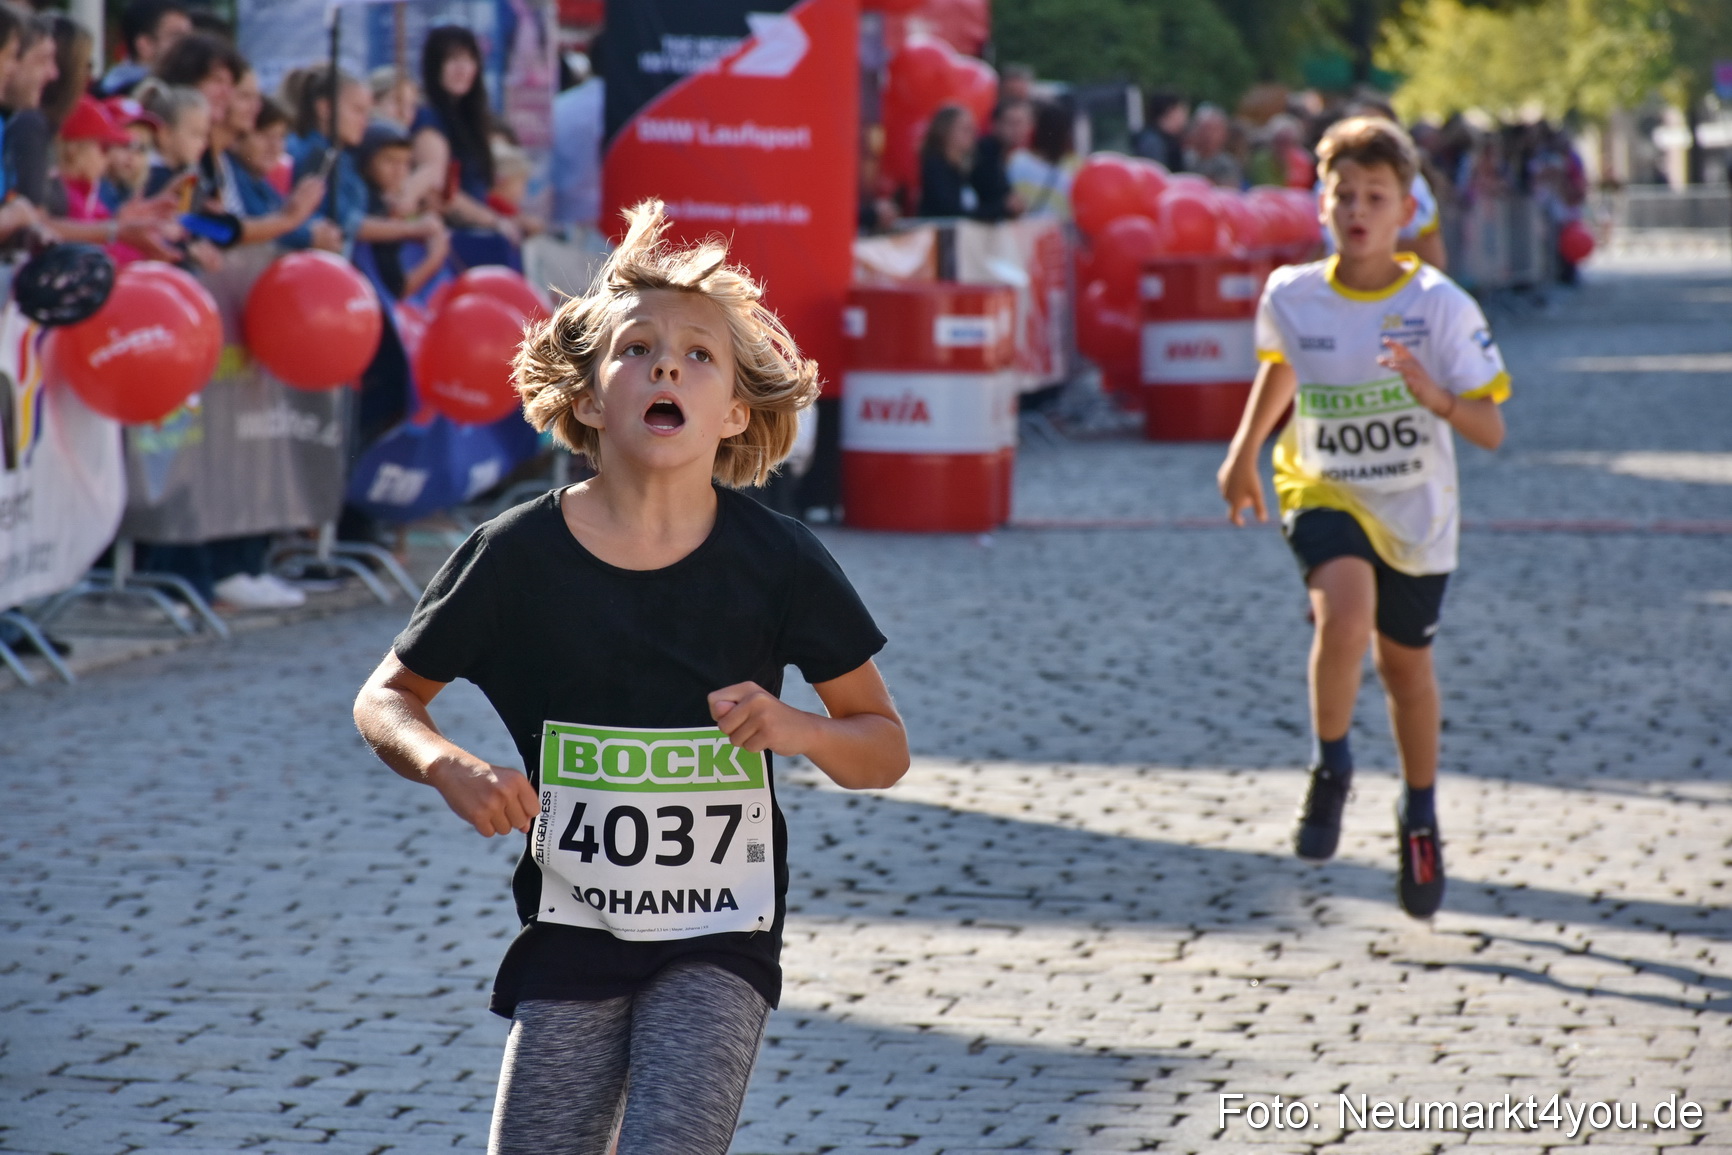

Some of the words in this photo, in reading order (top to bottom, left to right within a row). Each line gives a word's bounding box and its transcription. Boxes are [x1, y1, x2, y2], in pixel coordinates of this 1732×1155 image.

[1309, 386, 1405, 411] BOCK
[1316, 415, 1419, 456] 4006
[559, 735, 748, 782] BOCK
[752, 807, 761, 819] J
[558, 802, 743, 866] 4037
[571, 885, 739, 915] JOHANNA
